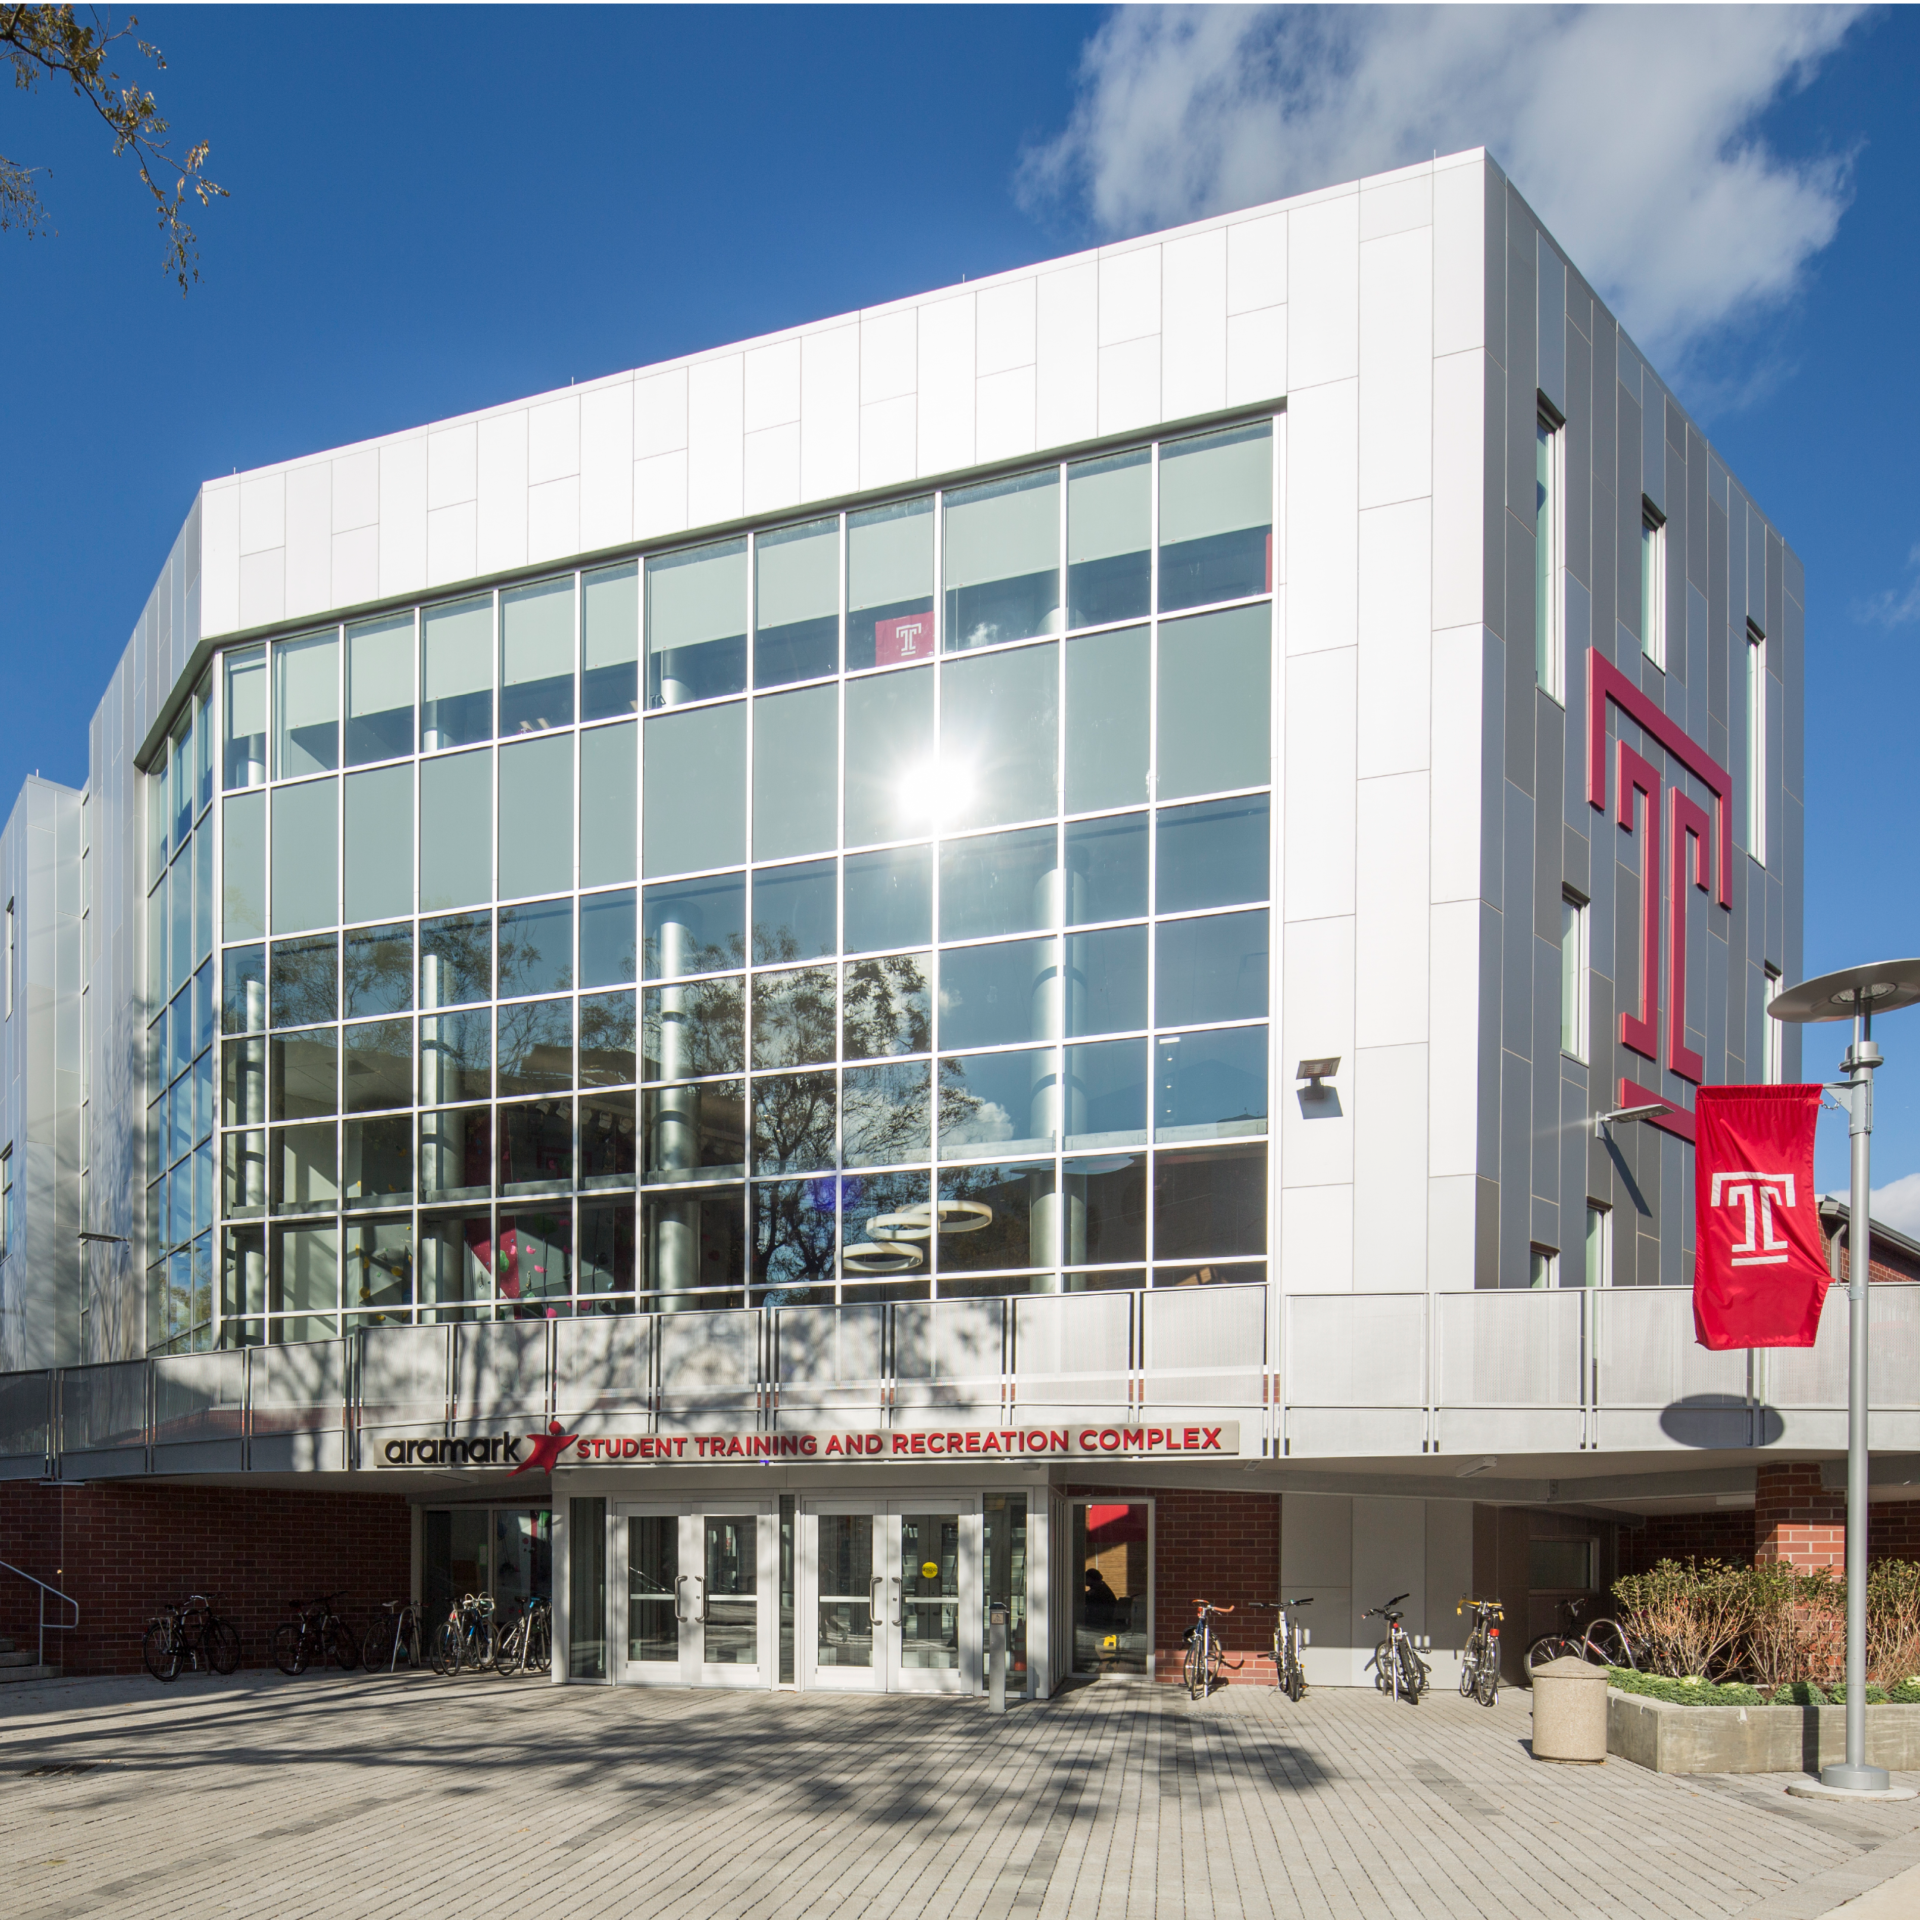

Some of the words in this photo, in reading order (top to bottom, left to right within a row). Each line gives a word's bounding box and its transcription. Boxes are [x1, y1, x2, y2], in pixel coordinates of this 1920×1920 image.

[896, 622, 921, 656] T
[1710, 1171, 1796, 1266] T
[384, 1431, 520, 1464] aramark
[577, 1437, 684, 1459] STUDENT
[695, 1435, 818, 1457] TRAINING
[825, 1433, 883, 1455] AND
[892, 1430, 1069, 1454] RECREATION
[1079, 1427, 1221, 1452] COMPLEX
